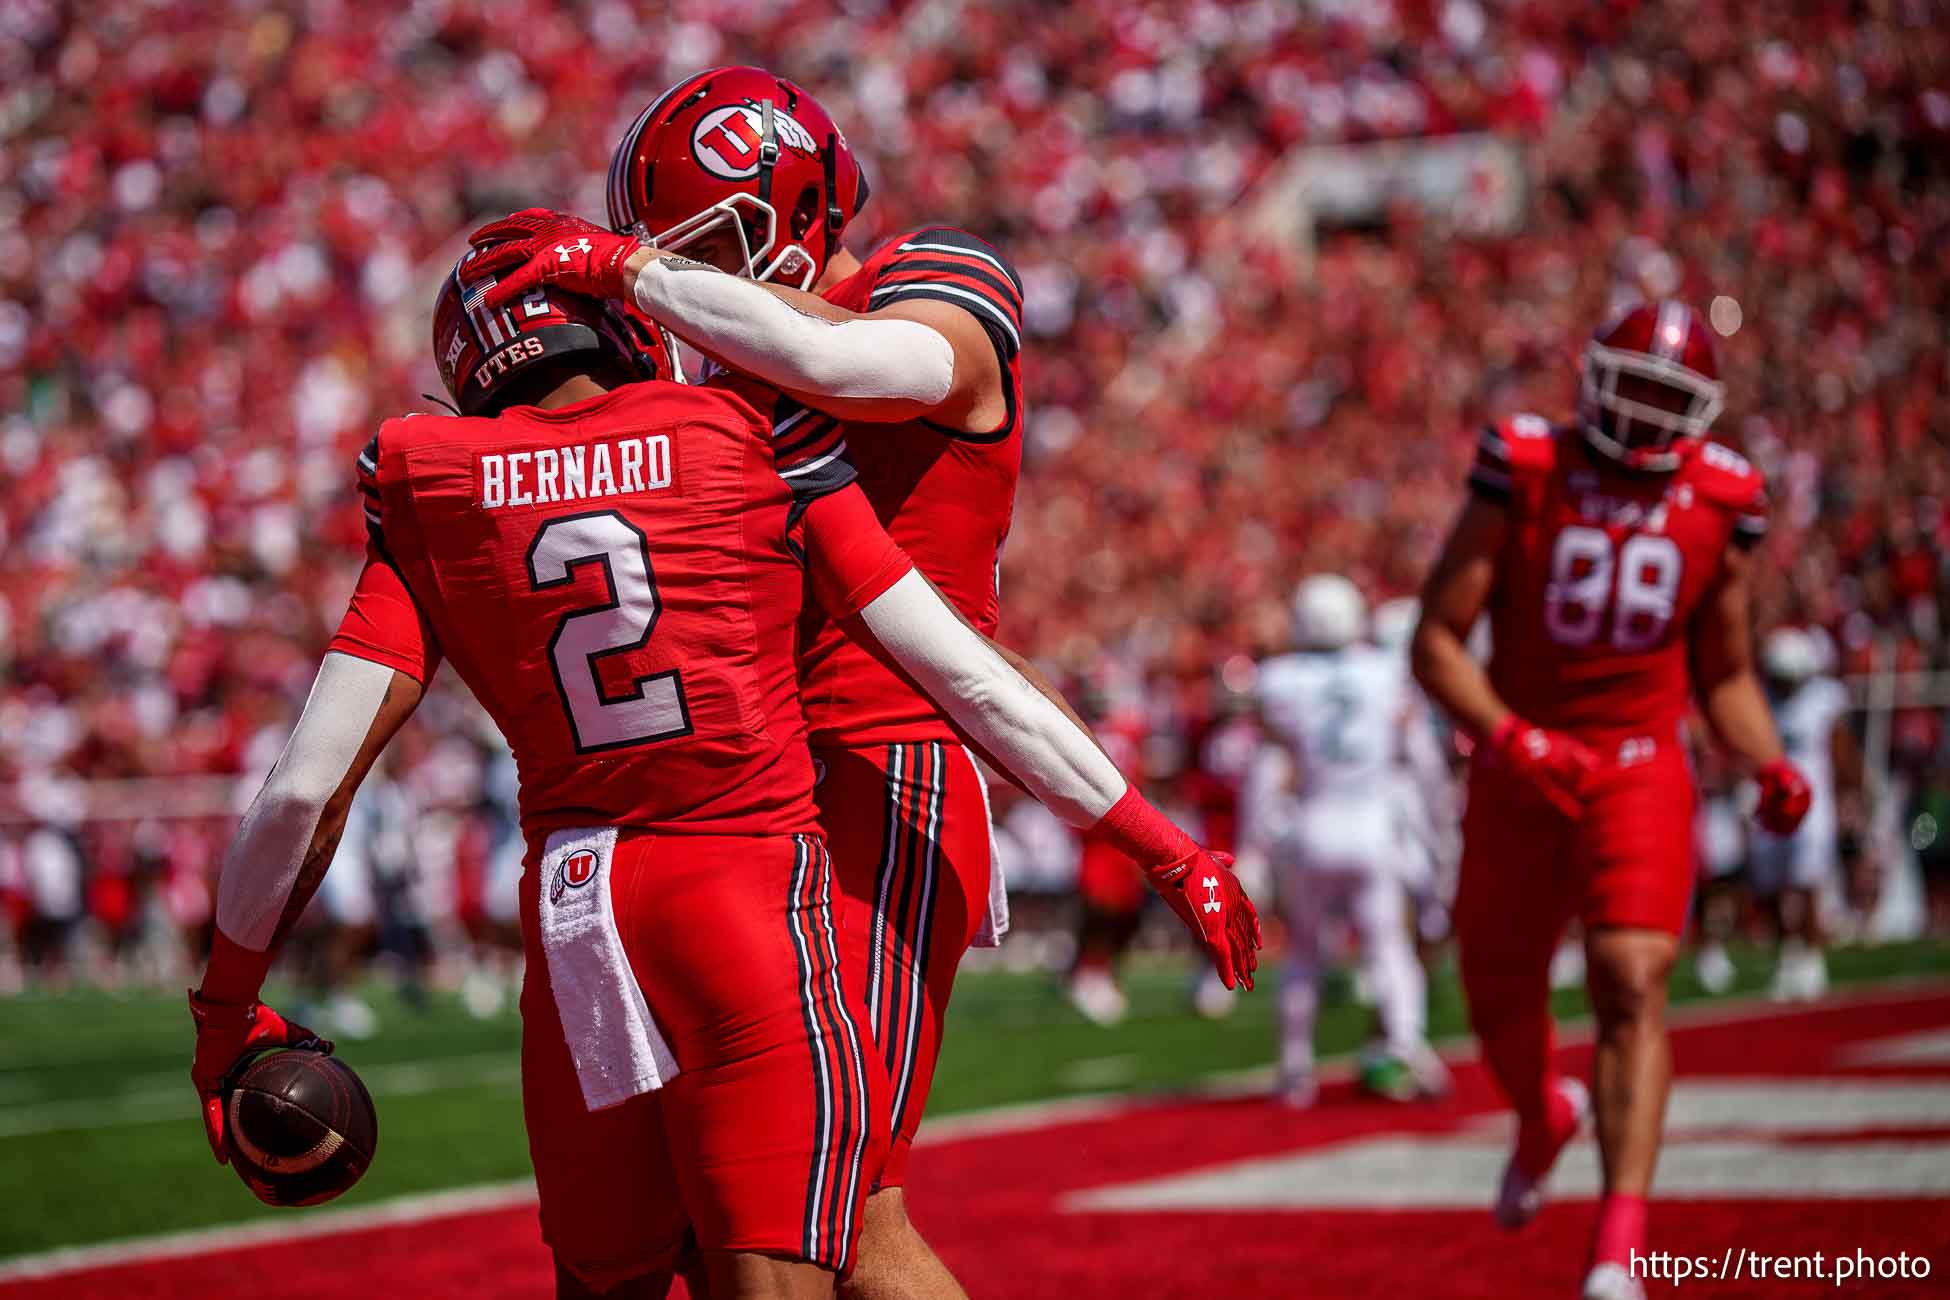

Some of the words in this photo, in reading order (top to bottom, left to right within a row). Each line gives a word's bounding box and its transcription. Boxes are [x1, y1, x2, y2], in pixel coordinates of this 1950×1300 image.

[475, 336, 544, 389] UTES
[481, 434, 671, 509] BERNARD
[1544, 524, 1683, 650] 88
[525, 509, 694, 755] 2
[568, 855, 593, 883] U
